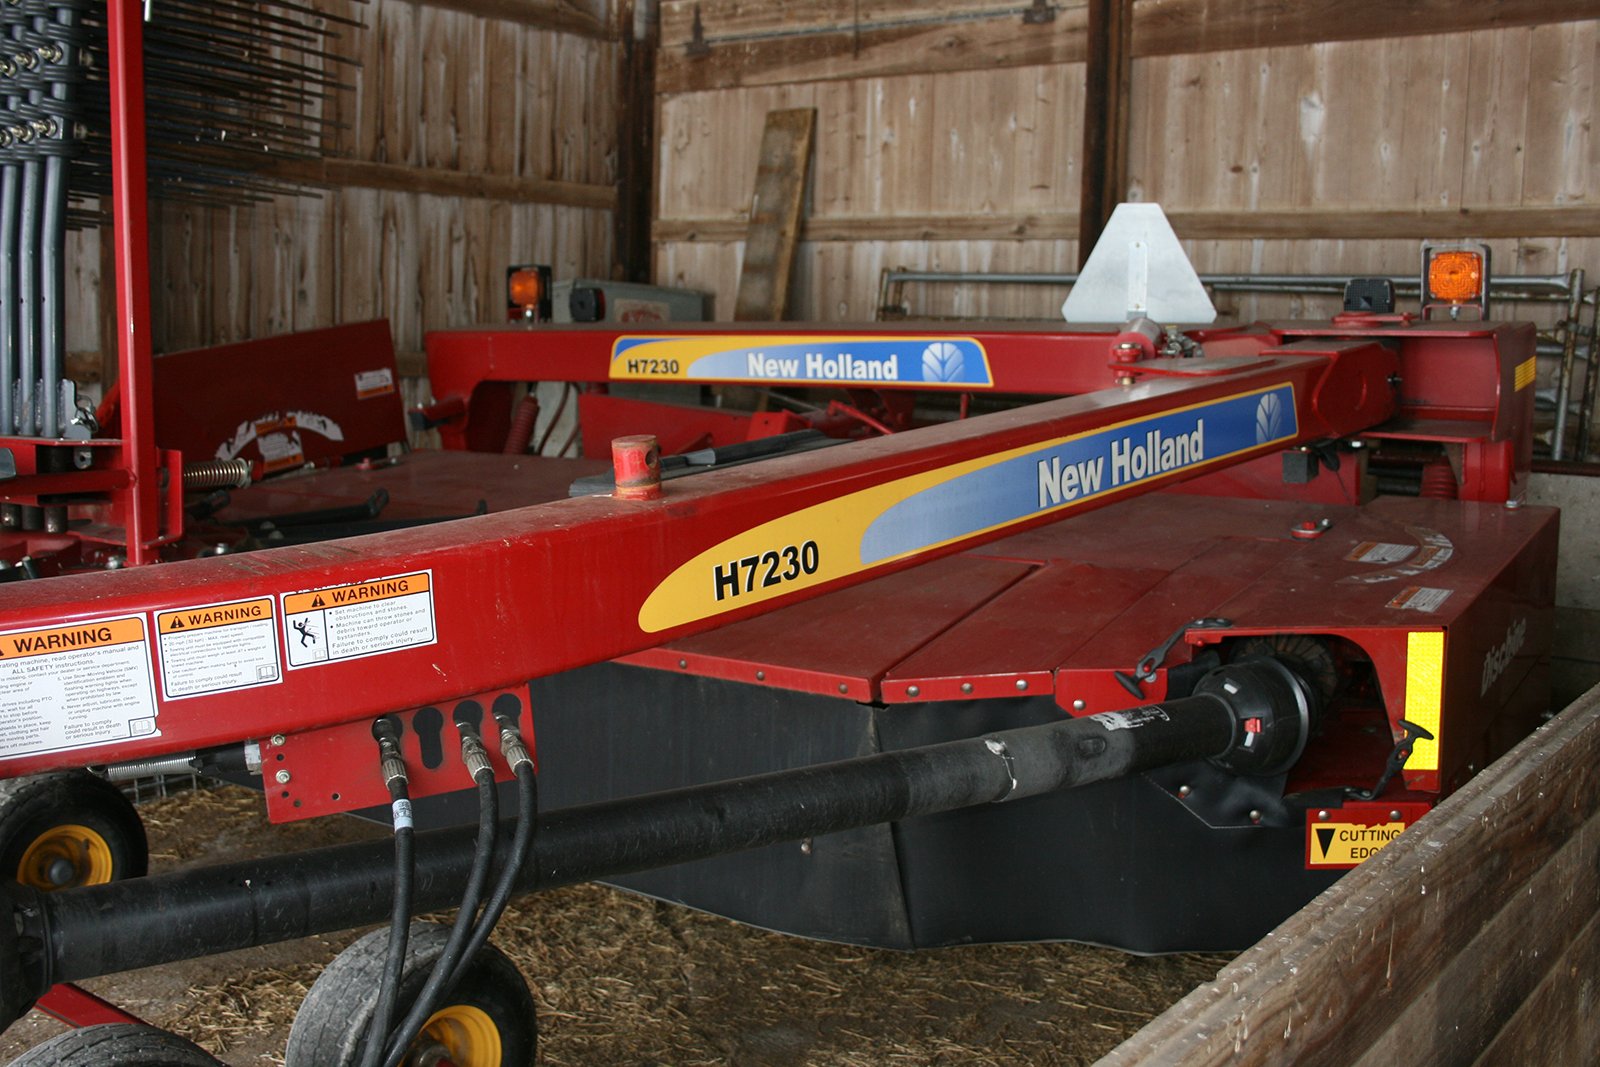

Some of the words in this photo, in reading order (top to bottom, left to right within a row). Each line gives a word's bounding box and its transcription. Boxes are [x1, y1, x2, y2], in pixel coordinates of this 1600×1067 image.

[628, 359, 679, 374] H7230
[747, 353, 799, 377] New
[806, 353, 897, 379] Holland
[1038, 456, 1103, 508] New
[1110, 419, 1203, 485] Holland
[713, 539, 819, 601] H7230
[332, 580, 408, 602] WARNING
[188, 606, 261, 625] WARNING
[335, 611, 373, 621] obstructions
[347, 604, 372, 613] machine
[336, 620, 362, 628] Machine
[379, 618, 405, 627] operator
[14, 628, 112, 653] WARNING
[332, 640, 355, 649] Failure
[366, 634, 388, 643] comply
[341, 646, 360, 654] death
[370, 639, 394, 648] serious
[67, 650, 101, 660] operator's
[102, 646, 126, 654] manual
[26, 663, 54, 672] SAFETY
[1350, 848, 1383, 859] EDG
